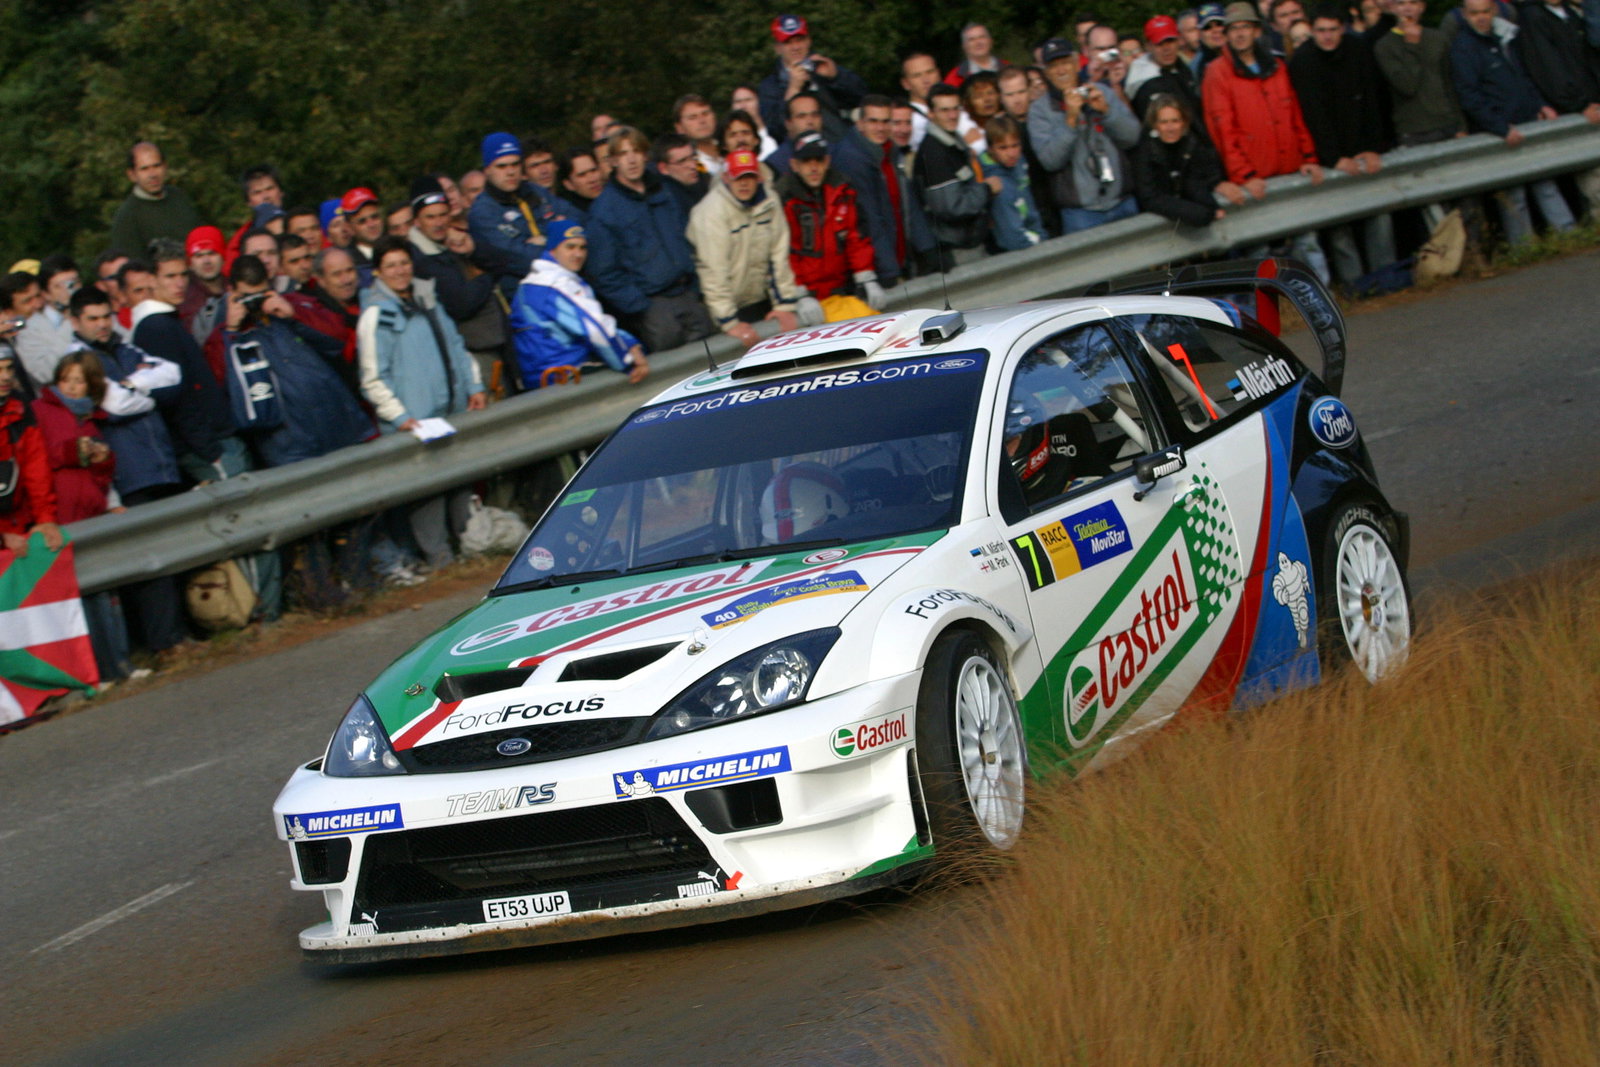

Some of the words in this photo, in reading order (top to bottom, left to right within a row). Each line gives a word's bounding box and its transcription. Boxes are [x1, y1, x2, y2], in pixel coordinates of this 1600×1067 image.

[664, 361, 930, 419] FordTeamRS.com
[1167, 343, 1219, 420] 7
[1235, 354, 1296, 400] Märtin
[1317, 402, 1353, 442] Ford
[1040, 526, 1067, 546] RACC
[1091, 530, 1126, 555] MoviStar
[1015, 534, 1044, 587] 7
[526, 564, 752, 633] Castrol
[714, 611, 737, 622] 40
[1098, 549, 1191, 709] Castrol
[442, 697, 605, 734] FordFocus
[857, 713, 907, 751] Castrol
[656, 752, 782, 787] MICHELIN
[447, 782, 558, 818] TEAMRS
[307, 808, 396, 832] MICHELIN
[487, 898, 529, 920] ET53
[532, 894, 565, 914] UJP
